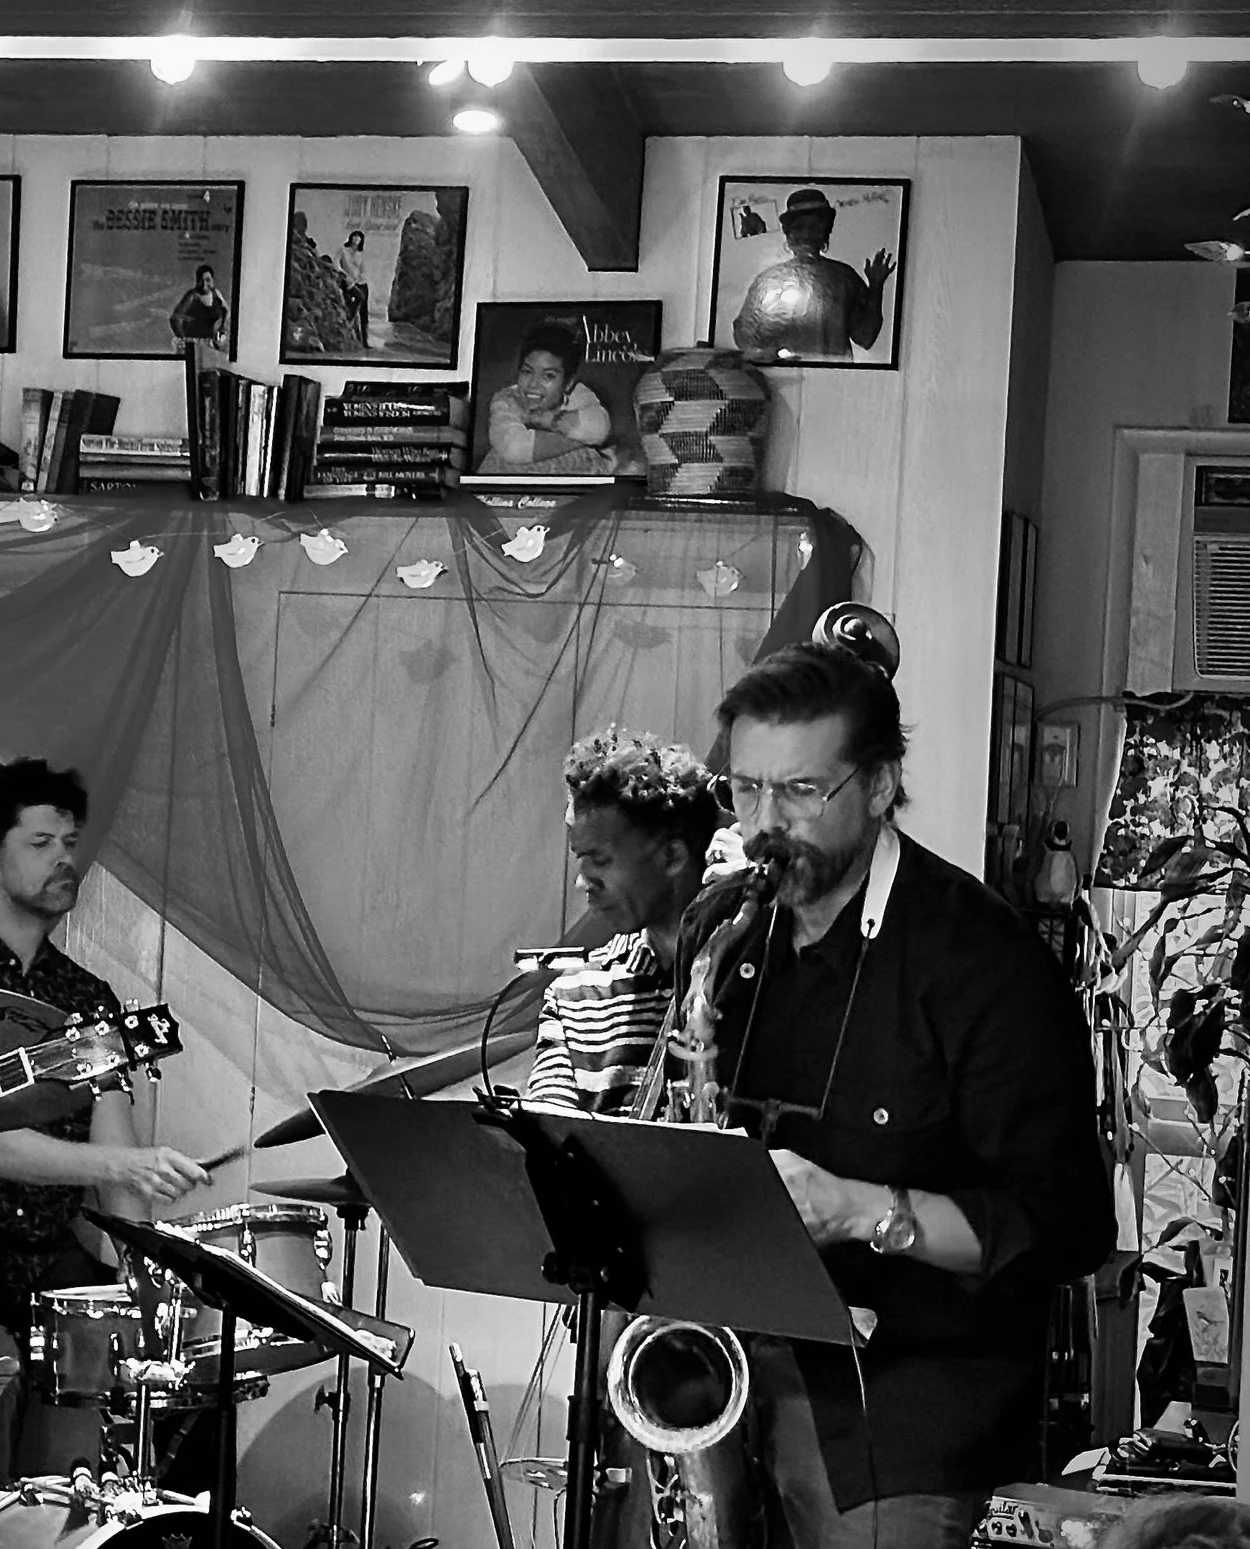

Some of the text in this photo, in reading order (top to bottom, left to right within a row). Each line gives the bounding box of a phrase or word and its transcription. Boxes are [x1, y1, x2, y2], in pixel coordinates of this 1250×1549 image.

[106, 209, 156, 231] BESSIE
[161, 209, 210, 232] SMITH
[582, 315, 631, 343] Abbey
